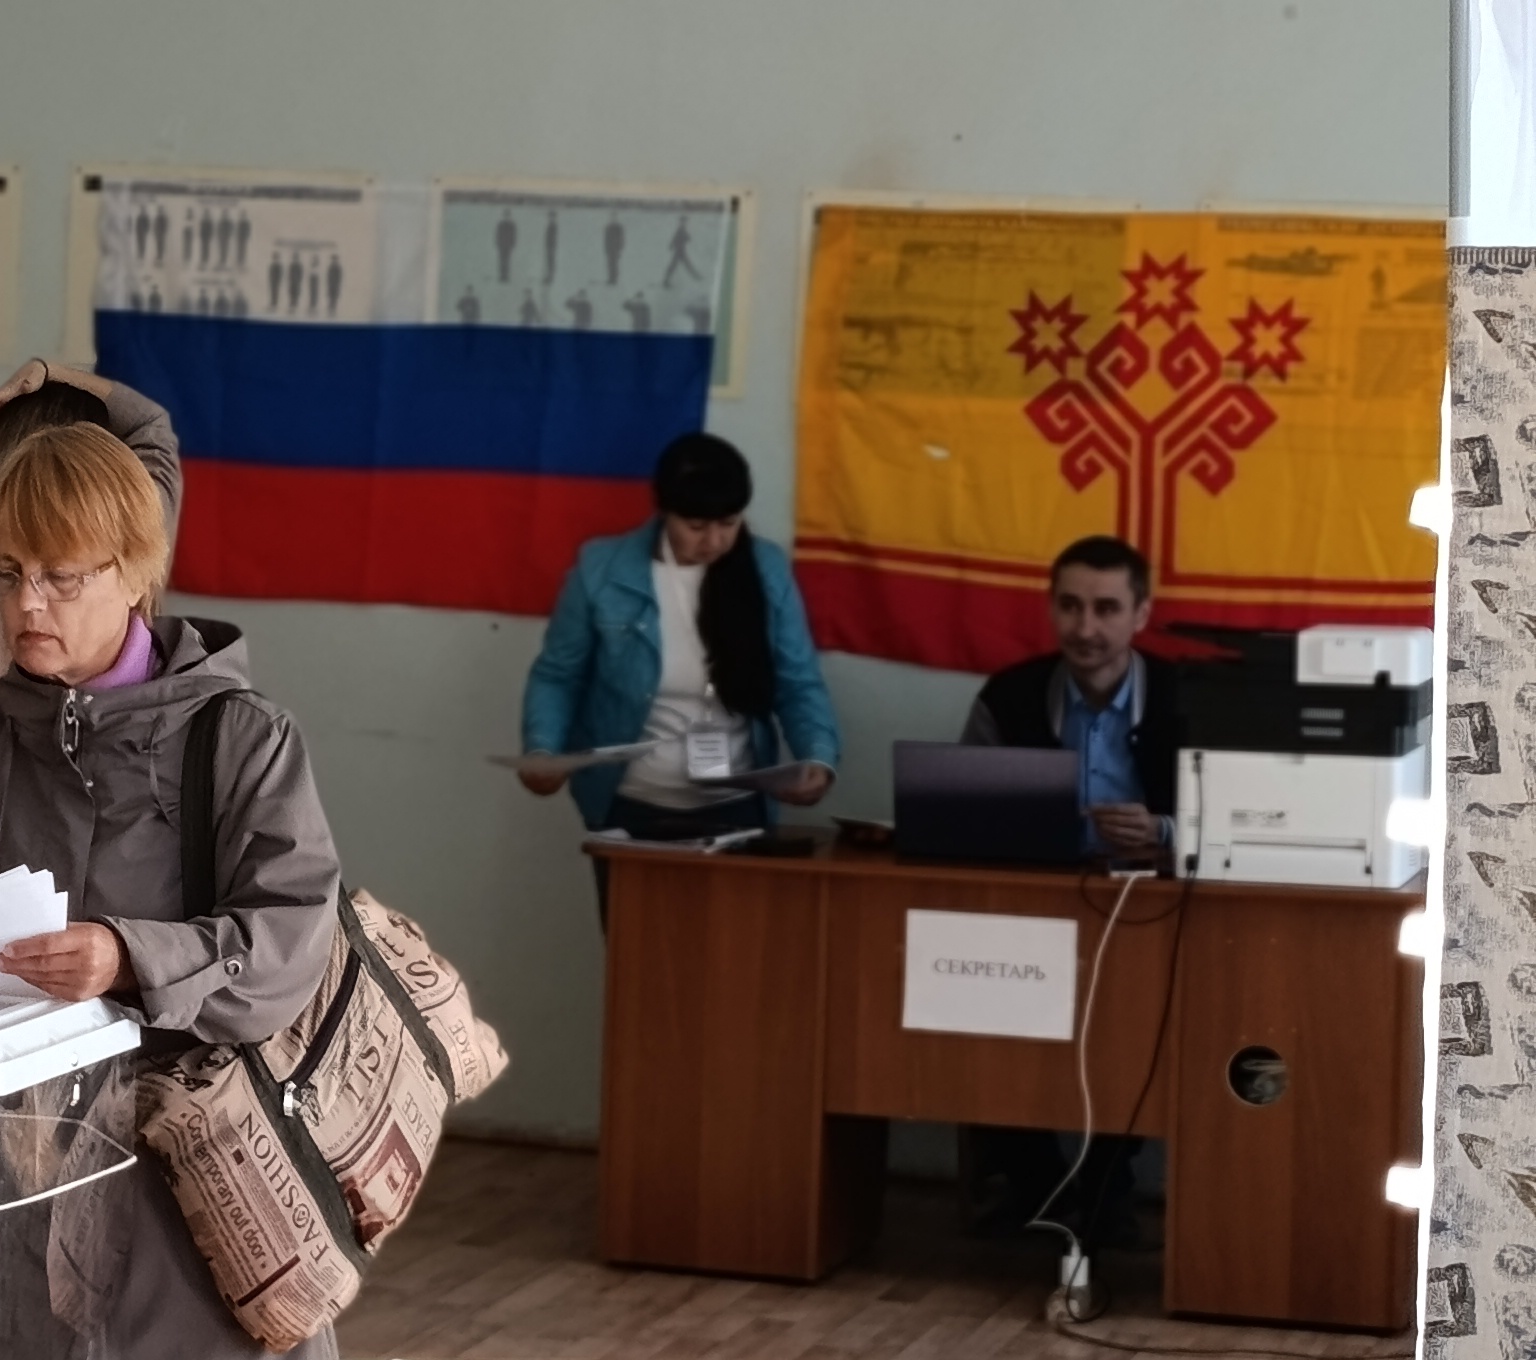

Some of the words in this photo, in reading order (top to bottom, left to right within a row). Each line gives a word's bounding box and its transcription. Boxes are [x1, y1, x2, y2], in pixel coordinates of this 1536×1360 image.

[933, 957, 1047, 981] СЕКРЕТАРЬ
[186, 1113, 232, 1209] Contemporary
[230, 1205, 252, 1232] out
[242, 1227, 267, 1263] door
